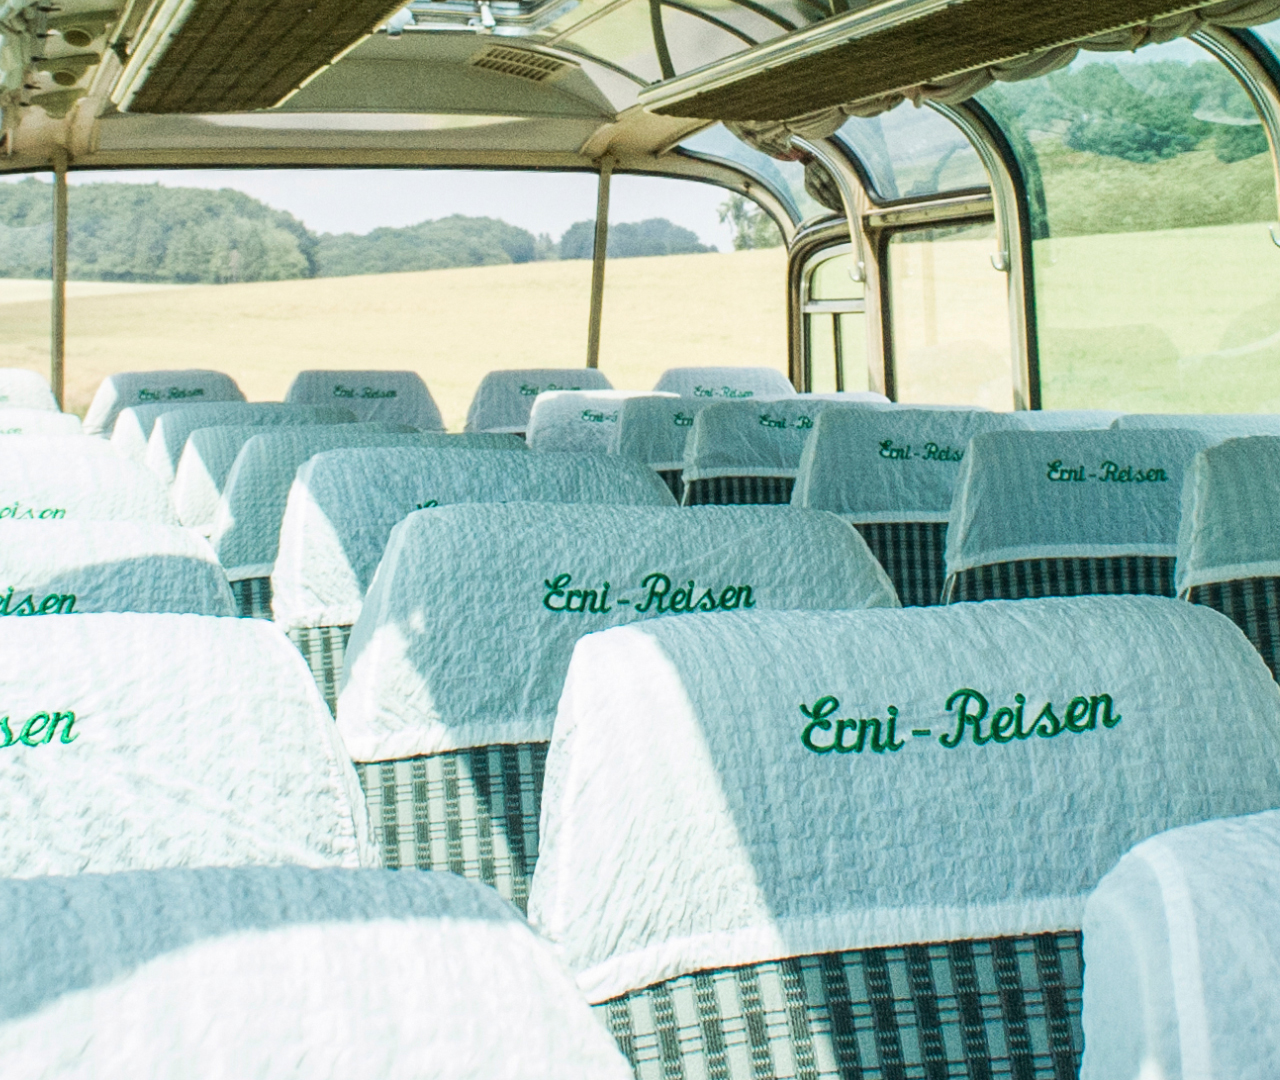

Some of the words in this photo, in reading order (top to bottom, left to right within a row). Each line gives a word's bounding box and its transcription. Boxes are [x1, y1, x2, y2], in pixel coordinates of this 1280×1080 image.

[878, 440, 964, 461] Erni-Reis
[1047, 459, 1168, 482] Erni-Reisen
[544, 572, 756, 614] Erni-Reisen
[799, 687, 1121, 755] Erni-Reisen
